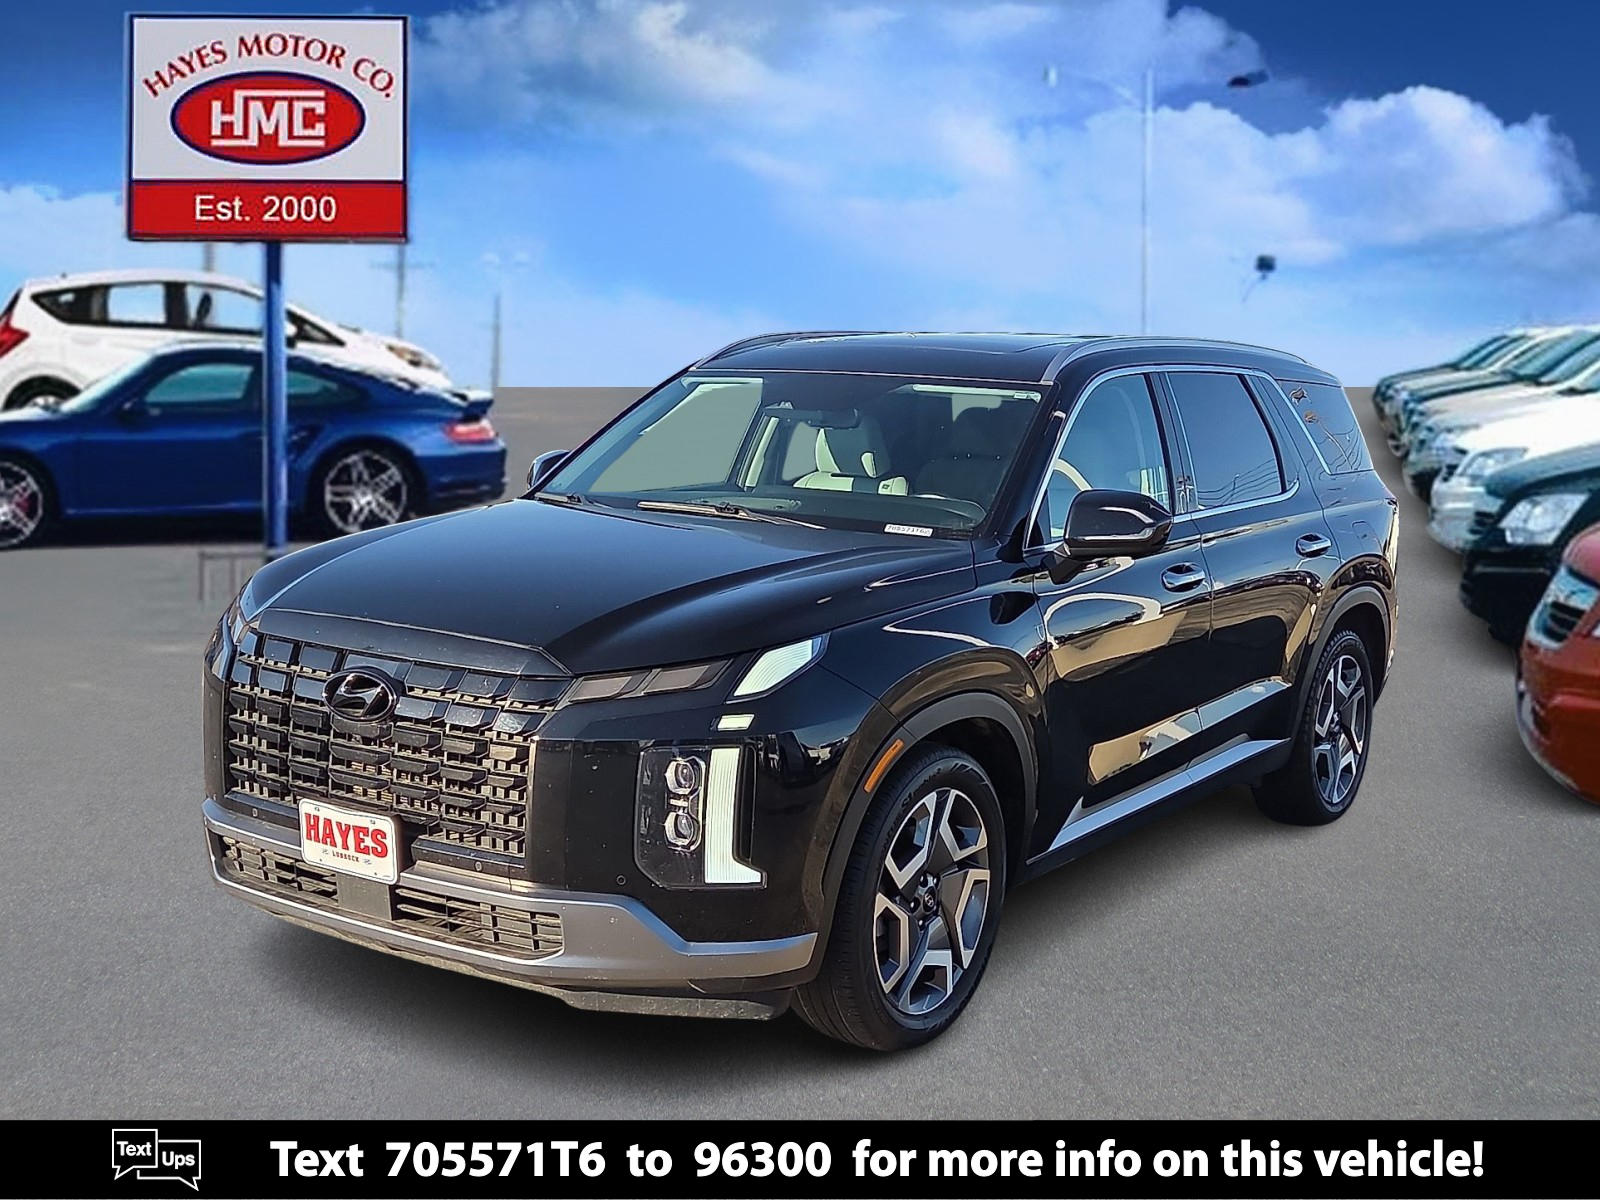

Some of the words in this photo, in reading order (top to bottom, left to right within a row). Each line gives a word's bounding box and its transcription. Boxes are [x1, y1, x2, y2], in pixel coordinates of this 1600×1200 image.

[142, 41, 228, 98] HAYES
[237, 33, 347, 70] MOTOR
[352, 57, 395, 98] CO.
[210, 89, 326, 147] HMC
[194, 194, 250, 222] Est.
[262, 195, 337, 222] 2000
[304, 812, 389, 858] HAYES
